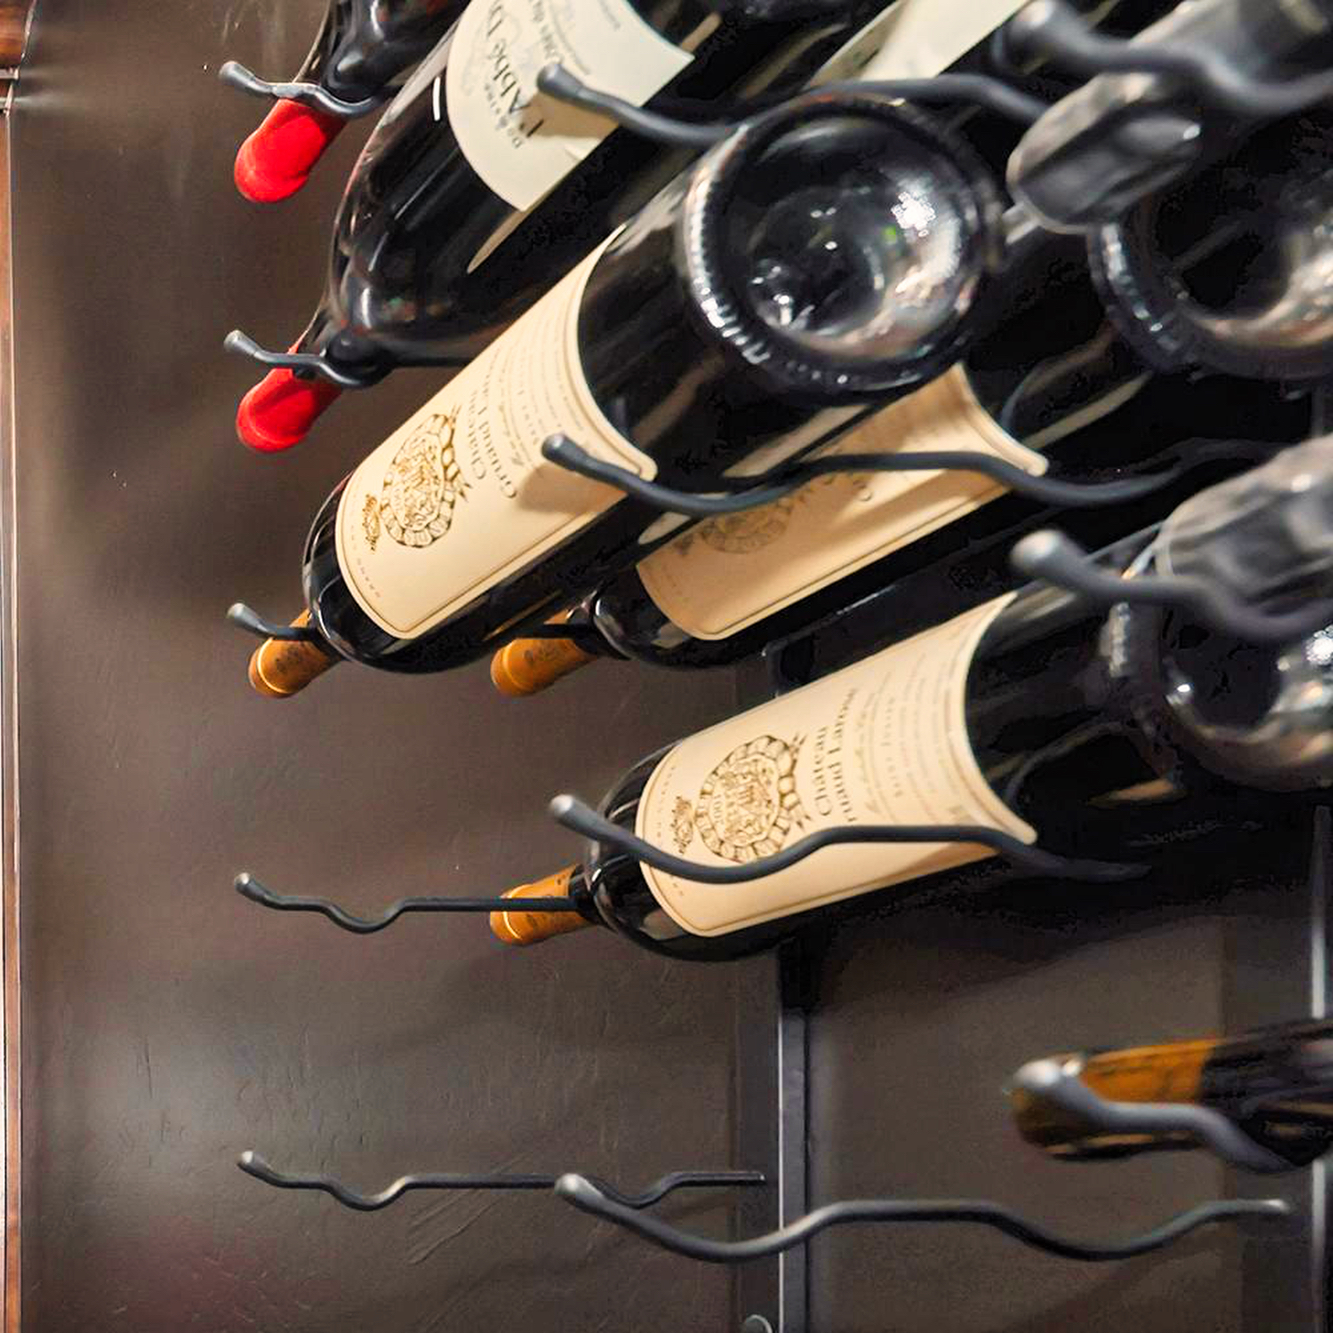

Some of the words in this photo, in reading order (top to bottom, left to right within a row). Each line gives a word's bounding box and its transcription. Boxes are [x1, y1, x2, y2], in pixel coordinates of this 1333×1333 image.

[484, 83, 524, 148] Doaine
[812, 725, 833, 817] Château
[827, 760, 858, 823] ruaud
